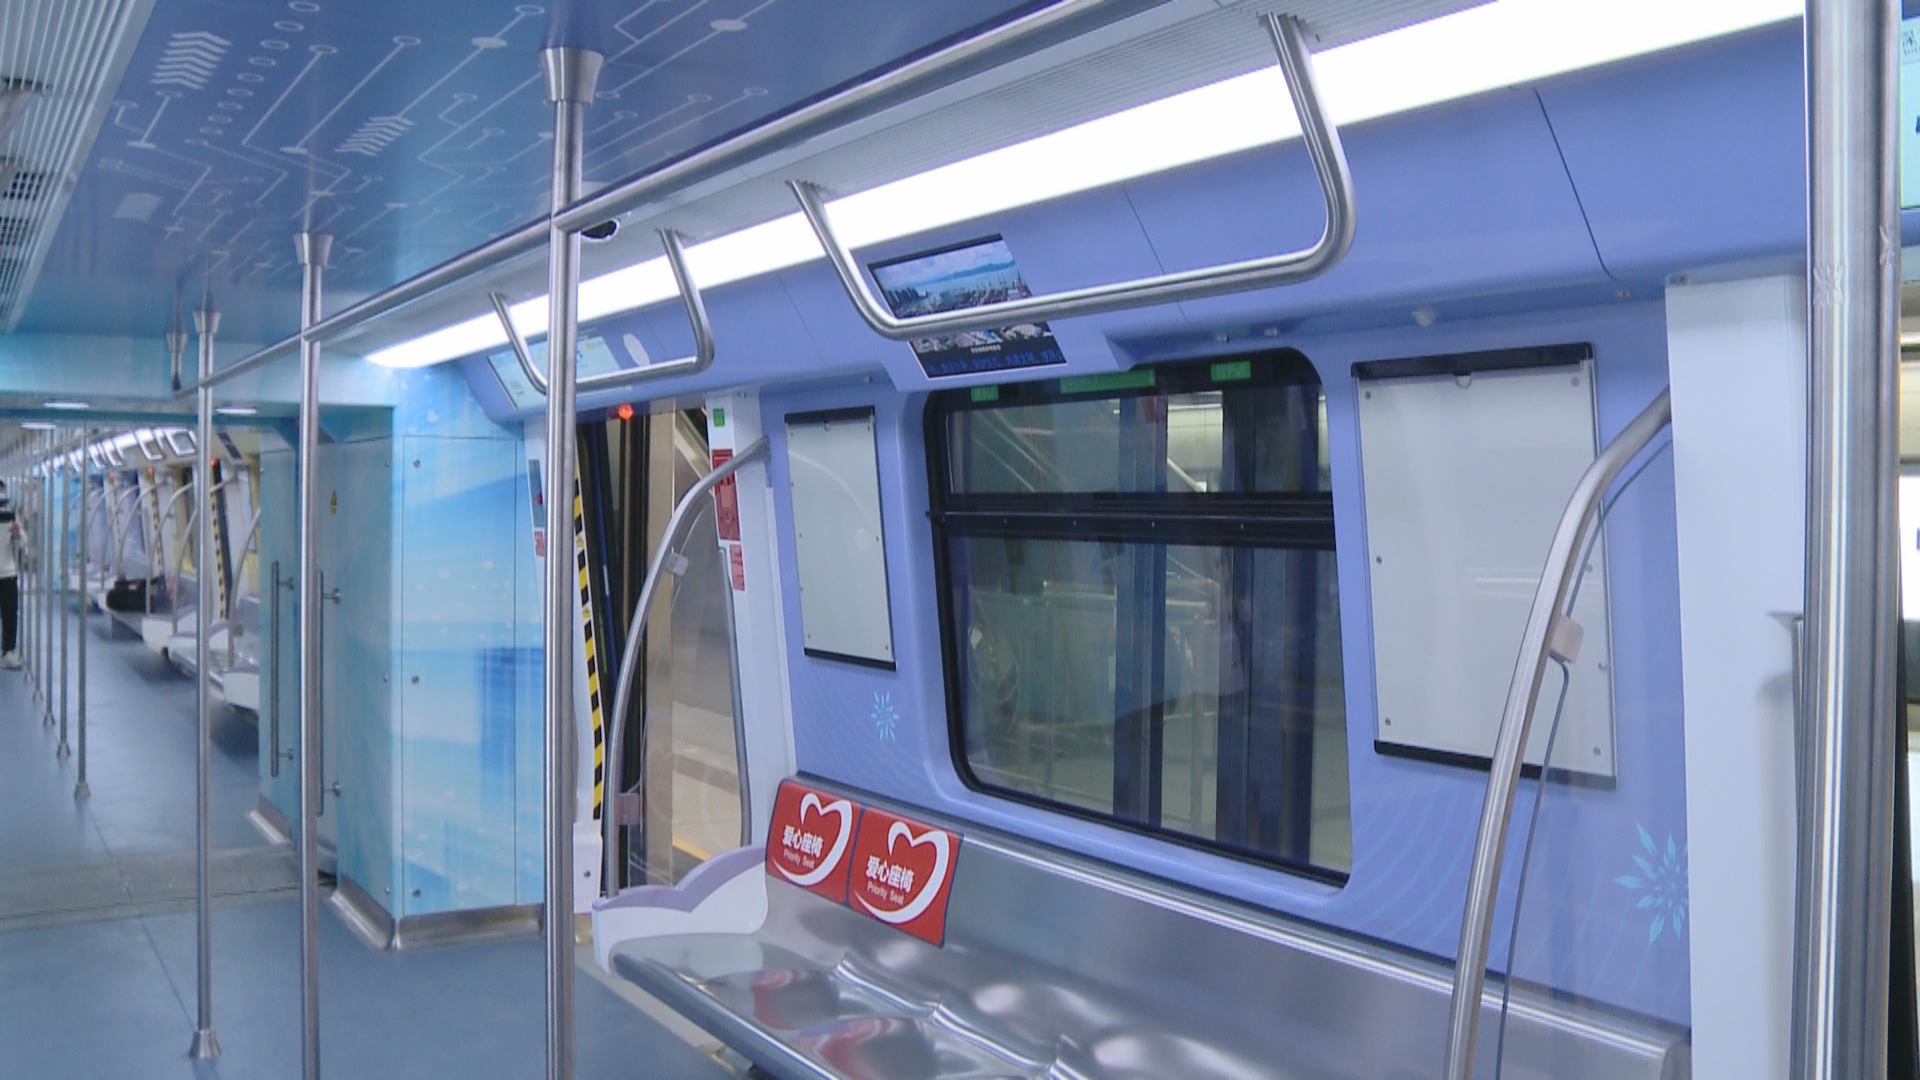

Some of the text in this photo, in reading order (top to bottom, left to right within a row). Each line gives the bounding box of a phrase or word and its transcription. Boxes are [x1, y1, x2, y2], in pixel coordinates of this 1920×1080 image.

[782, 824, 824, 858] 爱心座椅
[783, 848, 815, 869] Priority Seat
[865, 854, 915, 893] 爱心座椅
[867, 881, 904, 905] Priority Seat
